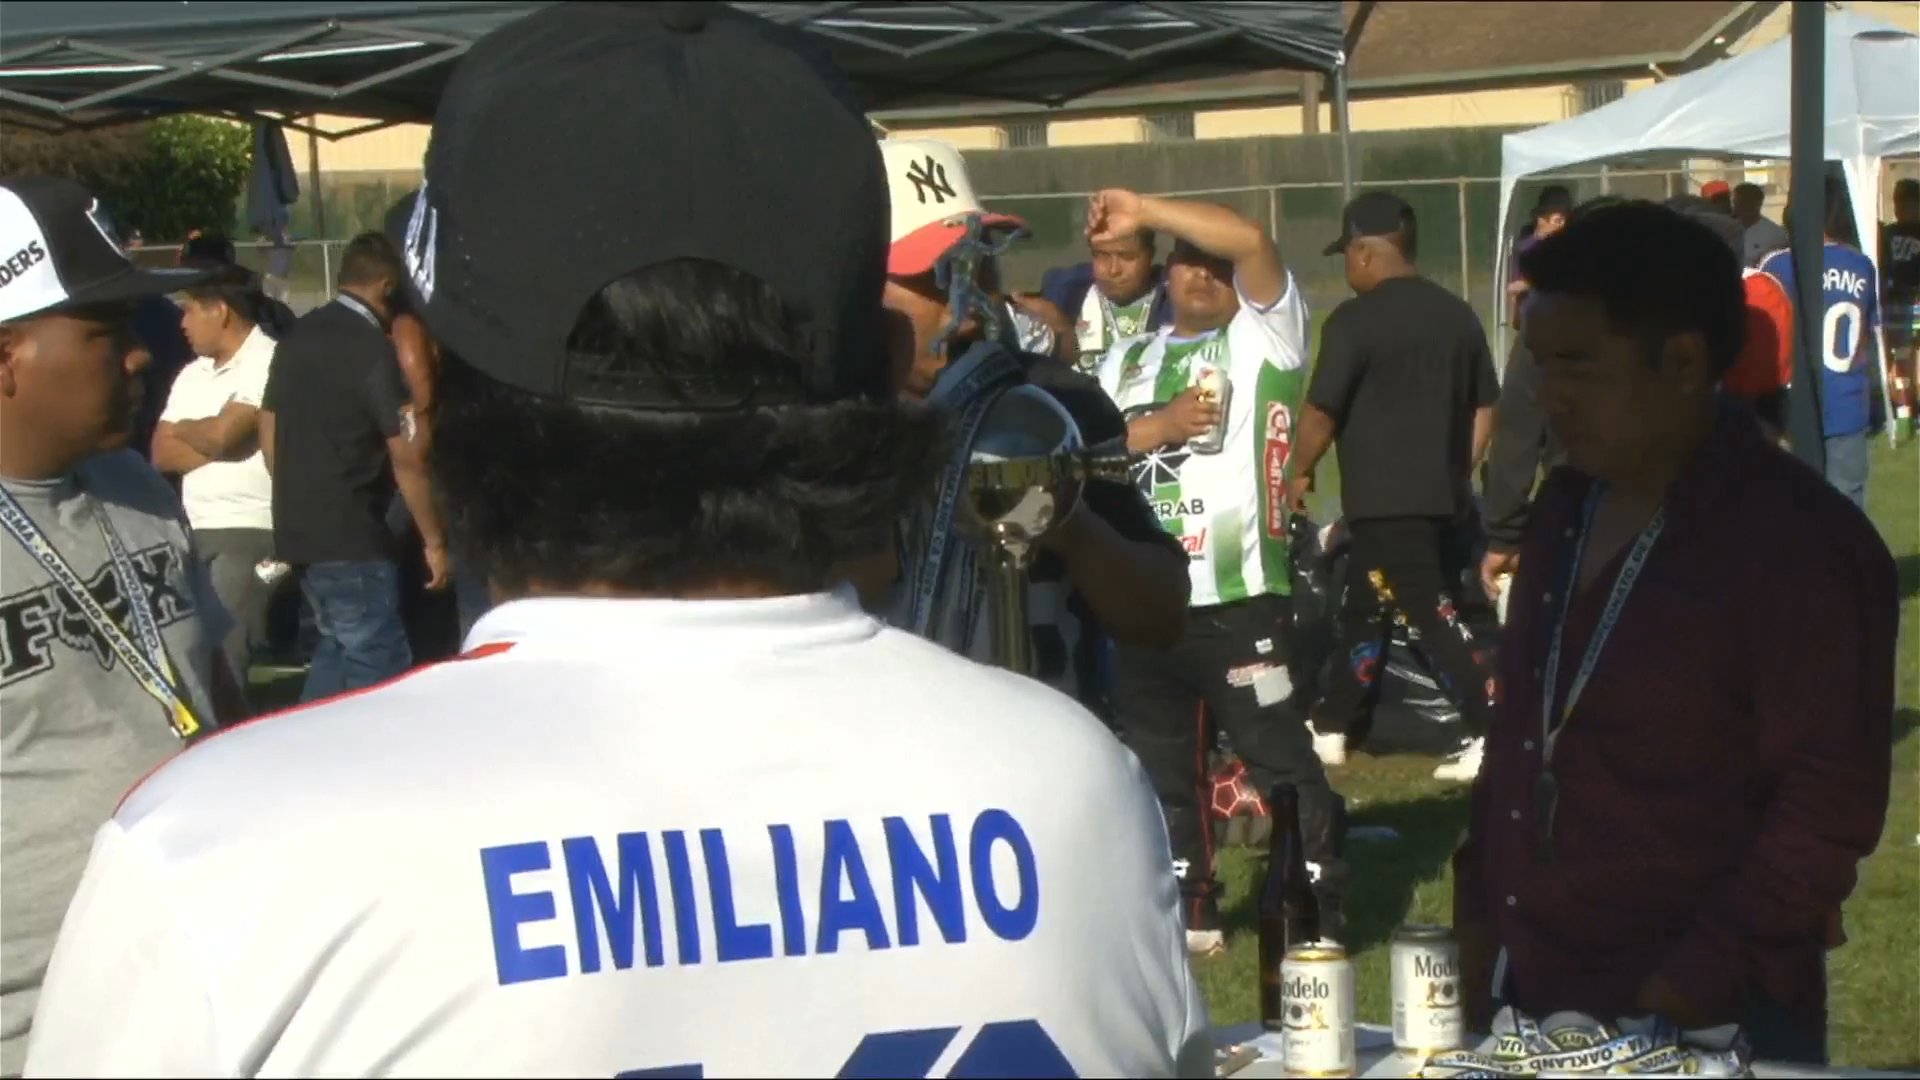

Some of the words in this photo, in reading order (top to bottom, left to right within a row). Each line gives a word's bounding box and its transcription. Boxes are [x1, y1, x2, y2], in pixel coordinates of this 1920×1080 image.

[0, 240, 45, 288] DERS
[1159, 498, 1206, 517] RAB
[0, 500, 35, 542] ESMA
[40, 551, 103, 627] OAKLAND
[479, 808, 1039, 986] EMILIANO
[1282, 976, 1330, 998] odelo
[1529, 1047, 1613, 1072] OAKLAND
